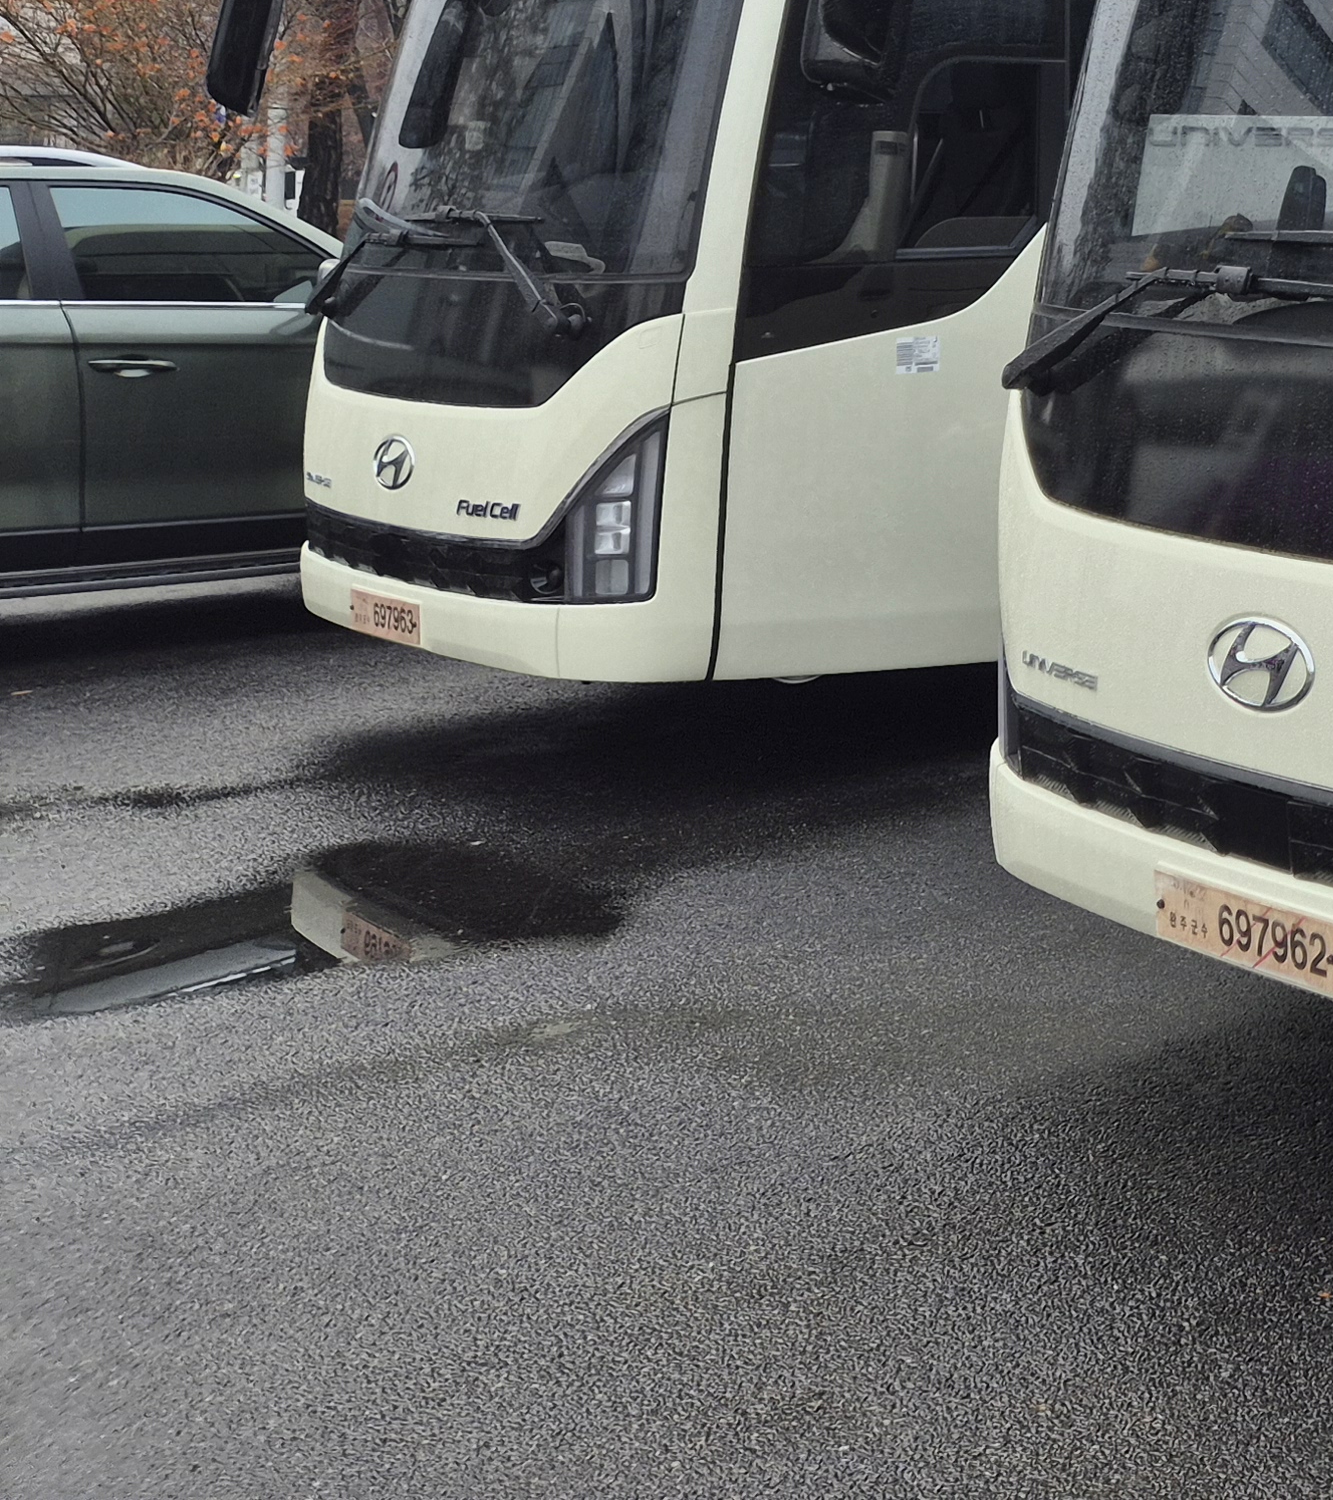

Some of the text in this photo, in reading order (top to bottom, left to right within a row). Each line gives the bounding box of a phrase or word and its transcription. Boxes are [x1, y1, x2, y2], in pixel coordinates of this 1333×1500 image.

[456, 499, 520, 521] Fuel Cell
[373, 602, 414, 634] 697963
[1218, 903, 1328, 978] 697962
